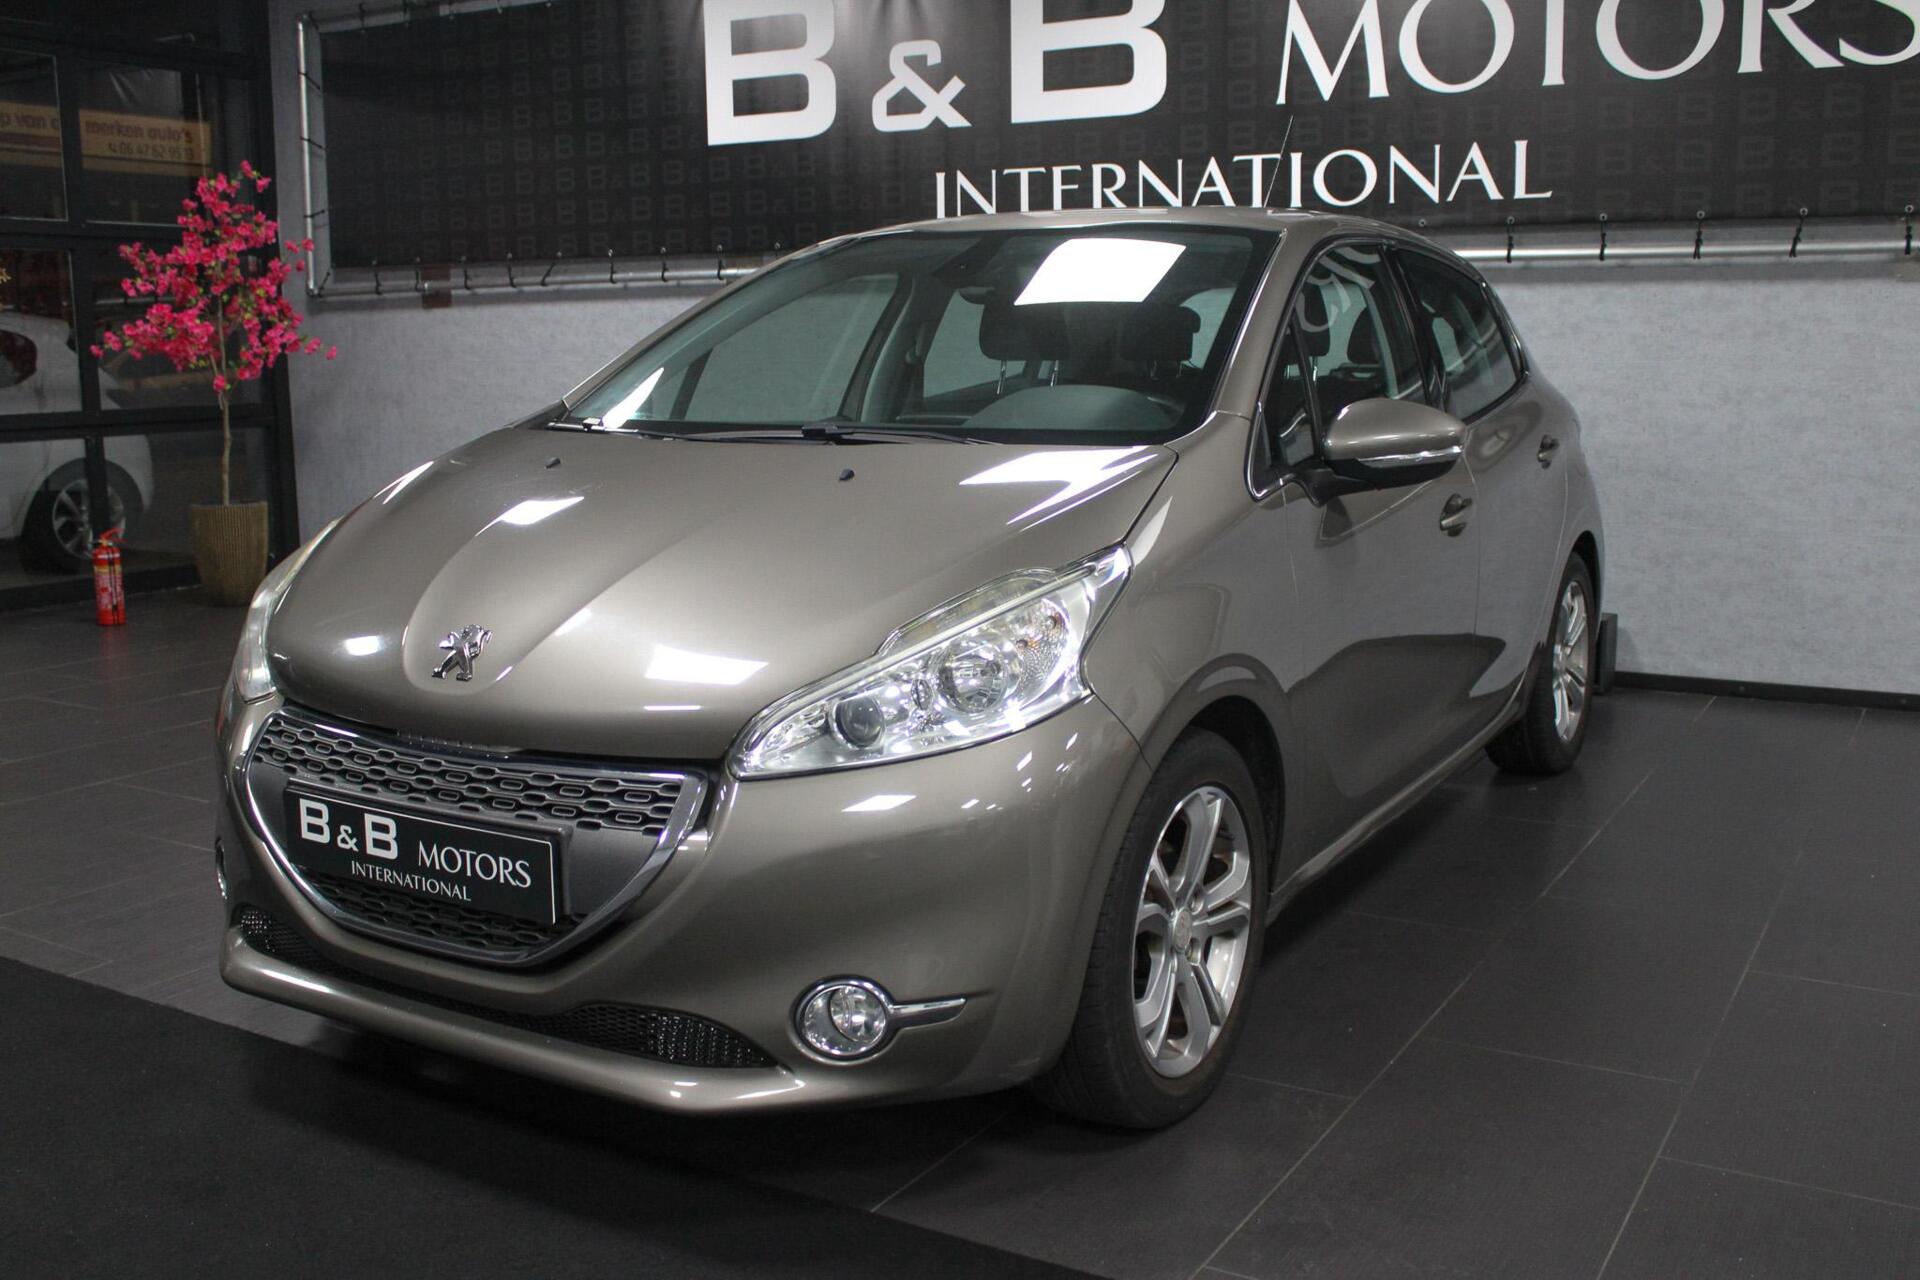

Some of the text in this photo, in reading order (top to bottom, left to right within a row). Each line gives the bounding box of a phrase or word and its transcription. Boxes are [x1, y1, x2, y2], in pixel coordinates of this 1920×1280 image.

[703, 0, 837, 145] B
[871, 39, 972, 132] &
[1010, 0, 1167, 123] B
[85, 120, 144, 138] merken
[935, 140, 1553, 219] INTERNATIONAL
[300, 798, 531, 888] B & B MOTORS
[351, 860, 472, 902] INTERNATIONAL
